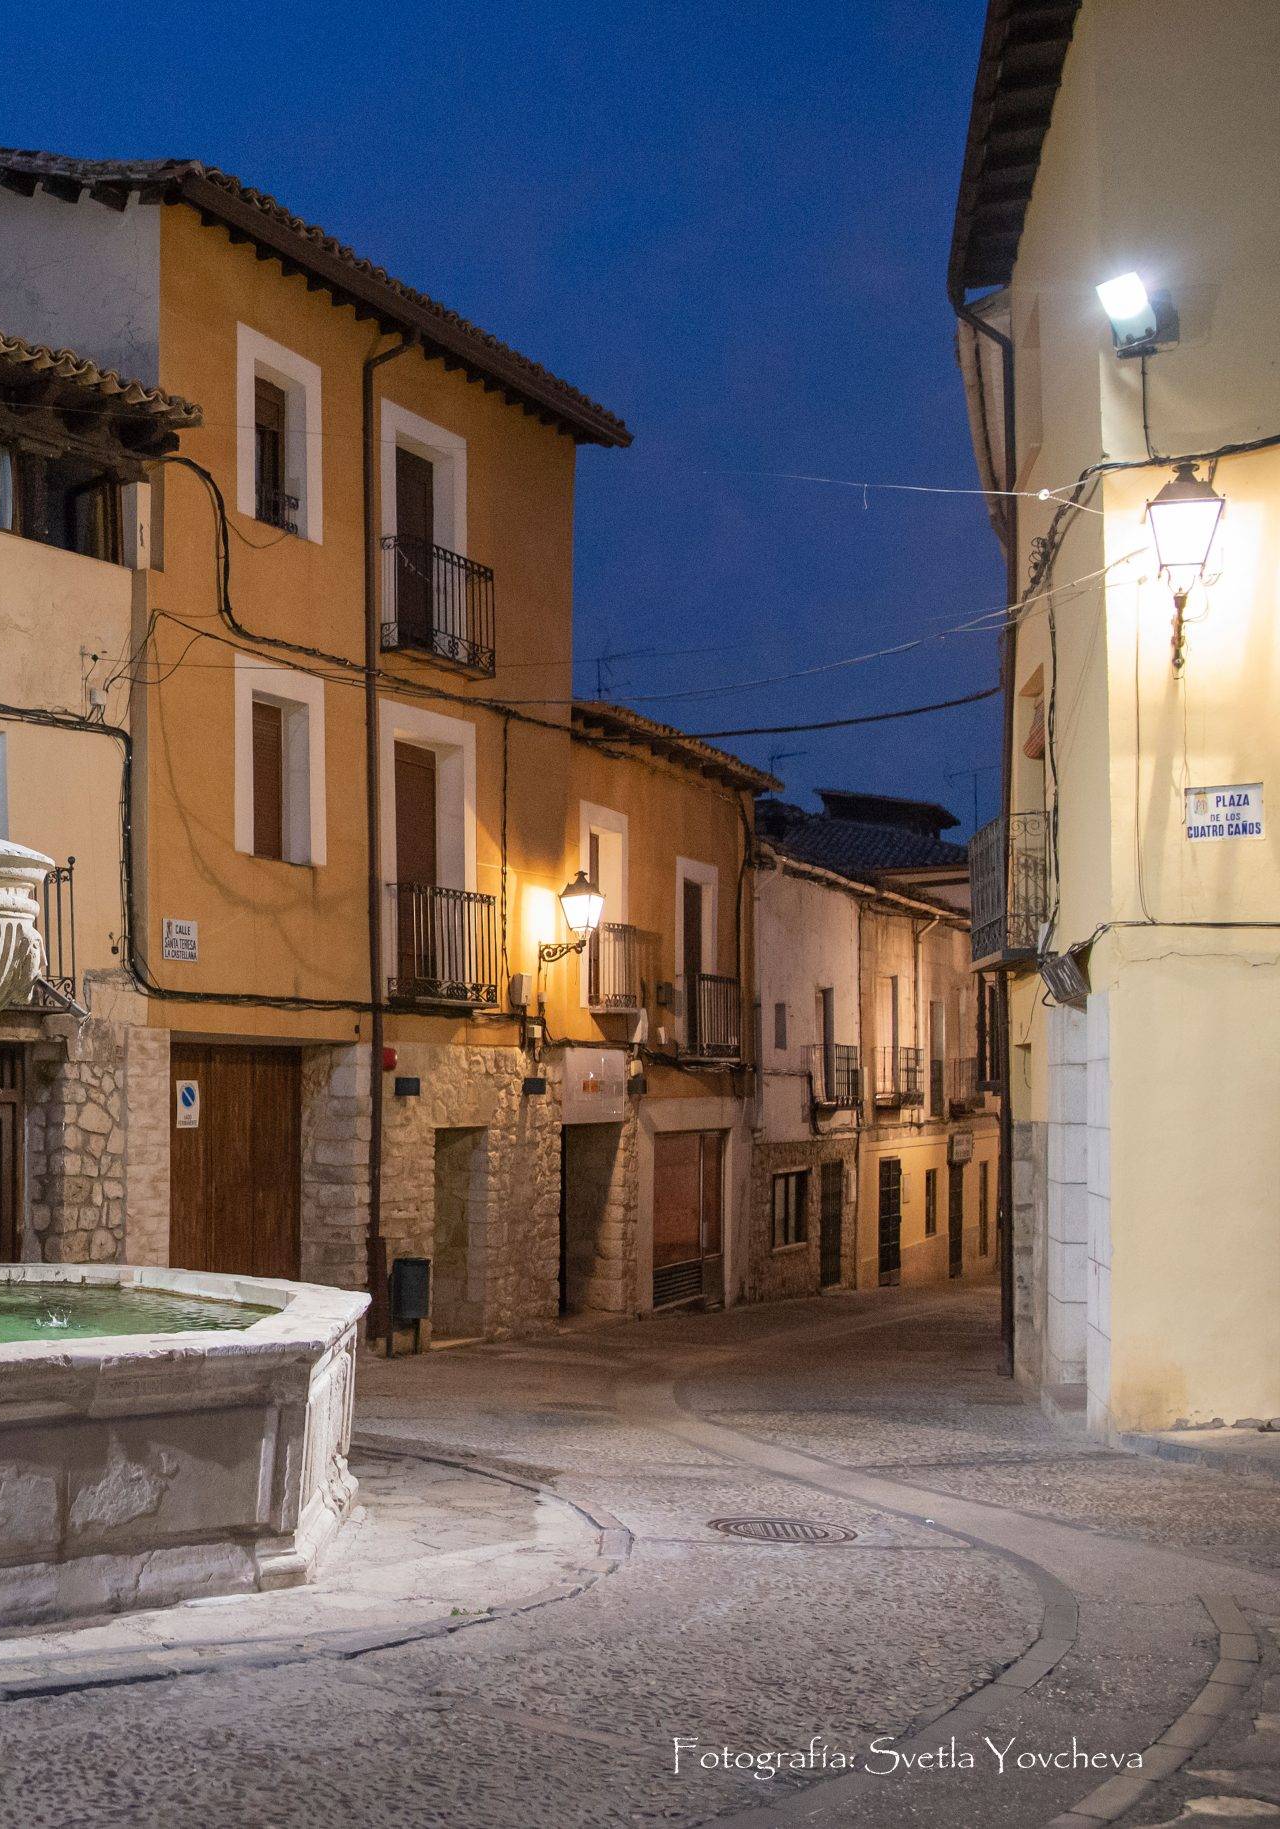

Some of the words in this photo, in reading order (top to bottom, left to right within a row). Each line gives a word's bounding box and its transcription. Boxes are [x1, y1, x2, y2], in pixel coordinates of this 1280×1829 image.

[1216, 794, 1249, 807] PLAZA
[1210, 814, 1220, 822] DE
[1225, 813, 1241, 821] LOS
[1187, 825, 1224, 838] CUATRO
[1227, 820, 1261, 836] CAÑOS
[176, 924, 191, 935] CALLE
[165, 937, 179, 949] SANTA
[179, 939, 196, 950] TERESA
[165, 949, 170, 957] LA
[171, 950, 197, 960] CASTELLANA
